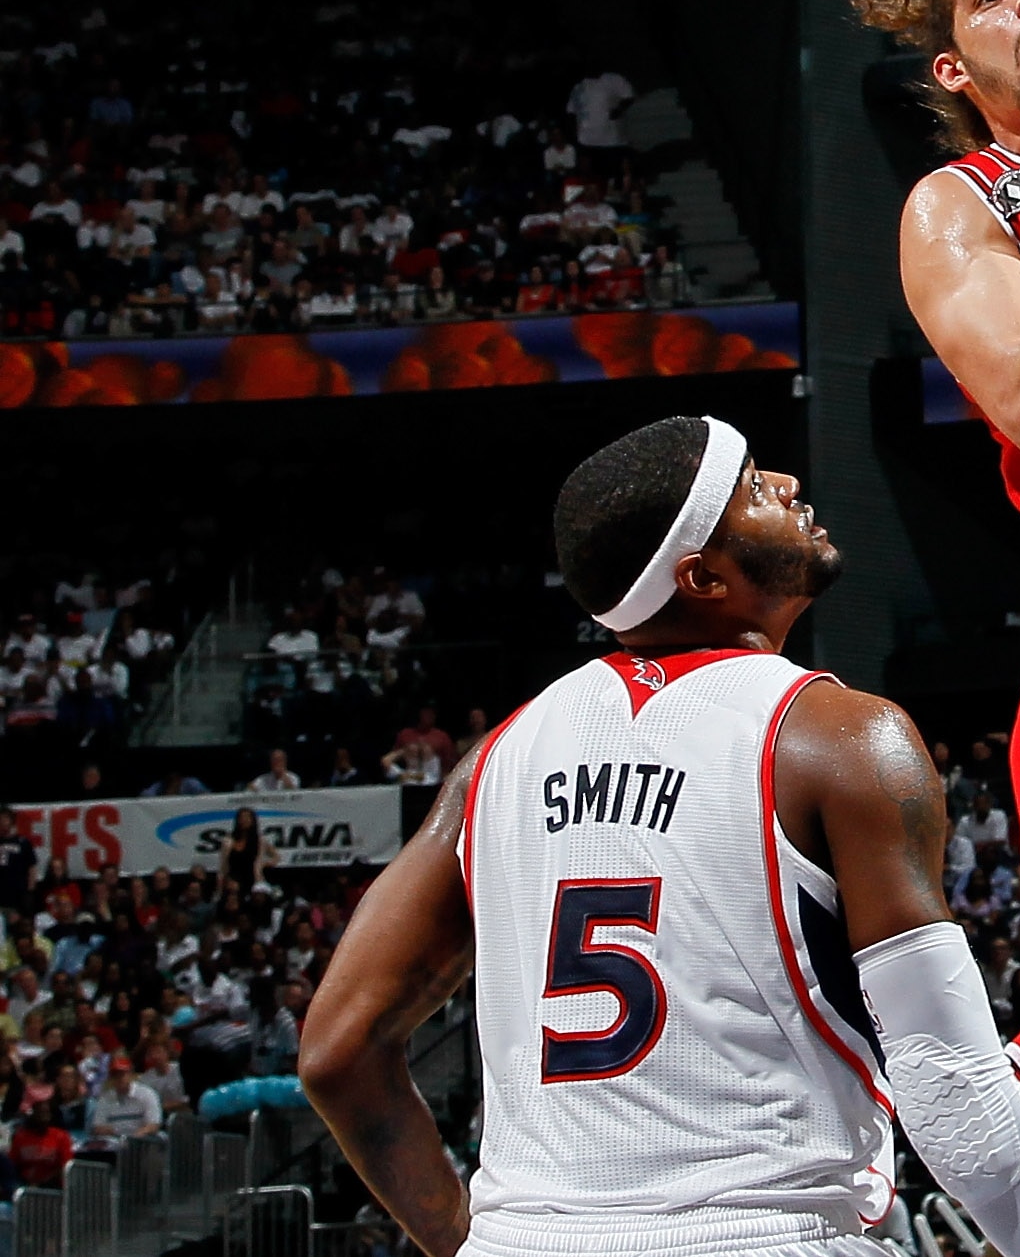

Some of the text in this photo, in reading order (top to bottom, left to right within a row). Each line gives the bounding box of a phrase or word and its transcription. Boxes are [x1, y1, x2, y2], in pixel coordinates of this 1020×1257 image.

[543, 762, 686, 834] SMITH
[194, 822, 353, 853] SANA
[541, 876, 668, 1085] 5
